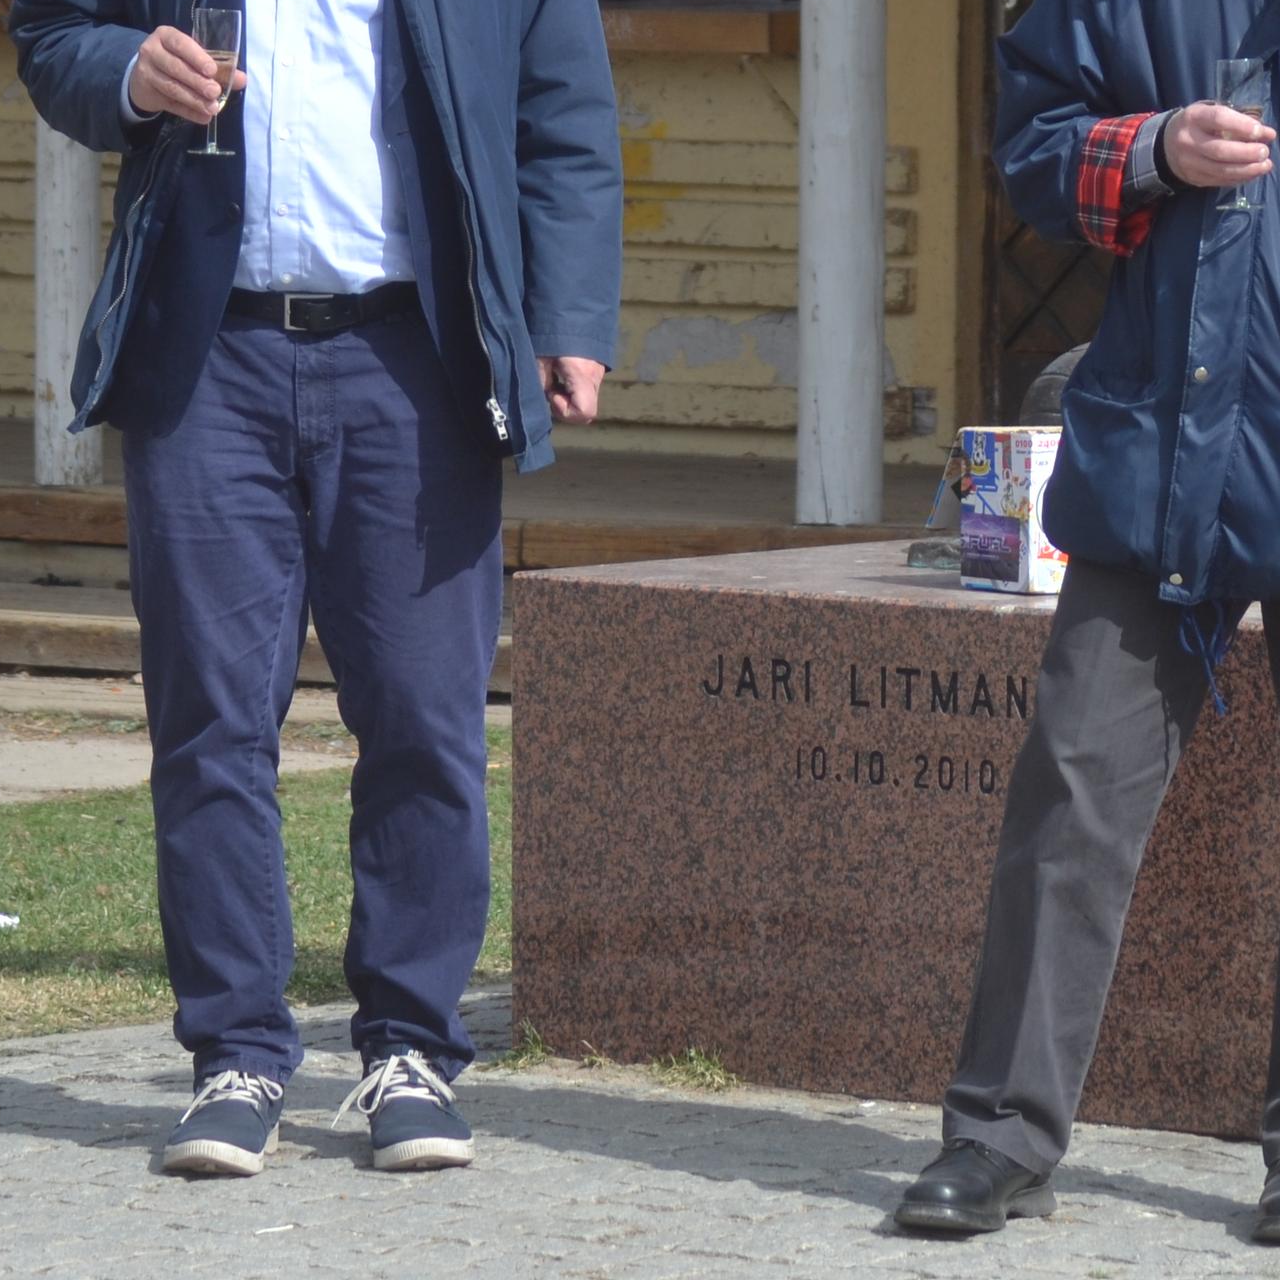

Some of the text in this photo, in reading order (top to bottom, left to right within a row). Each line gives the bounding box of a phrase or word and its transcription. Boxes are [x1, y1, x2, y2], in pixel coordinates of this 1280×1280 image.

[703, 654, 1028, 720] JARI LITMAN
[796, 745, 996, 795] 10.10.2010
